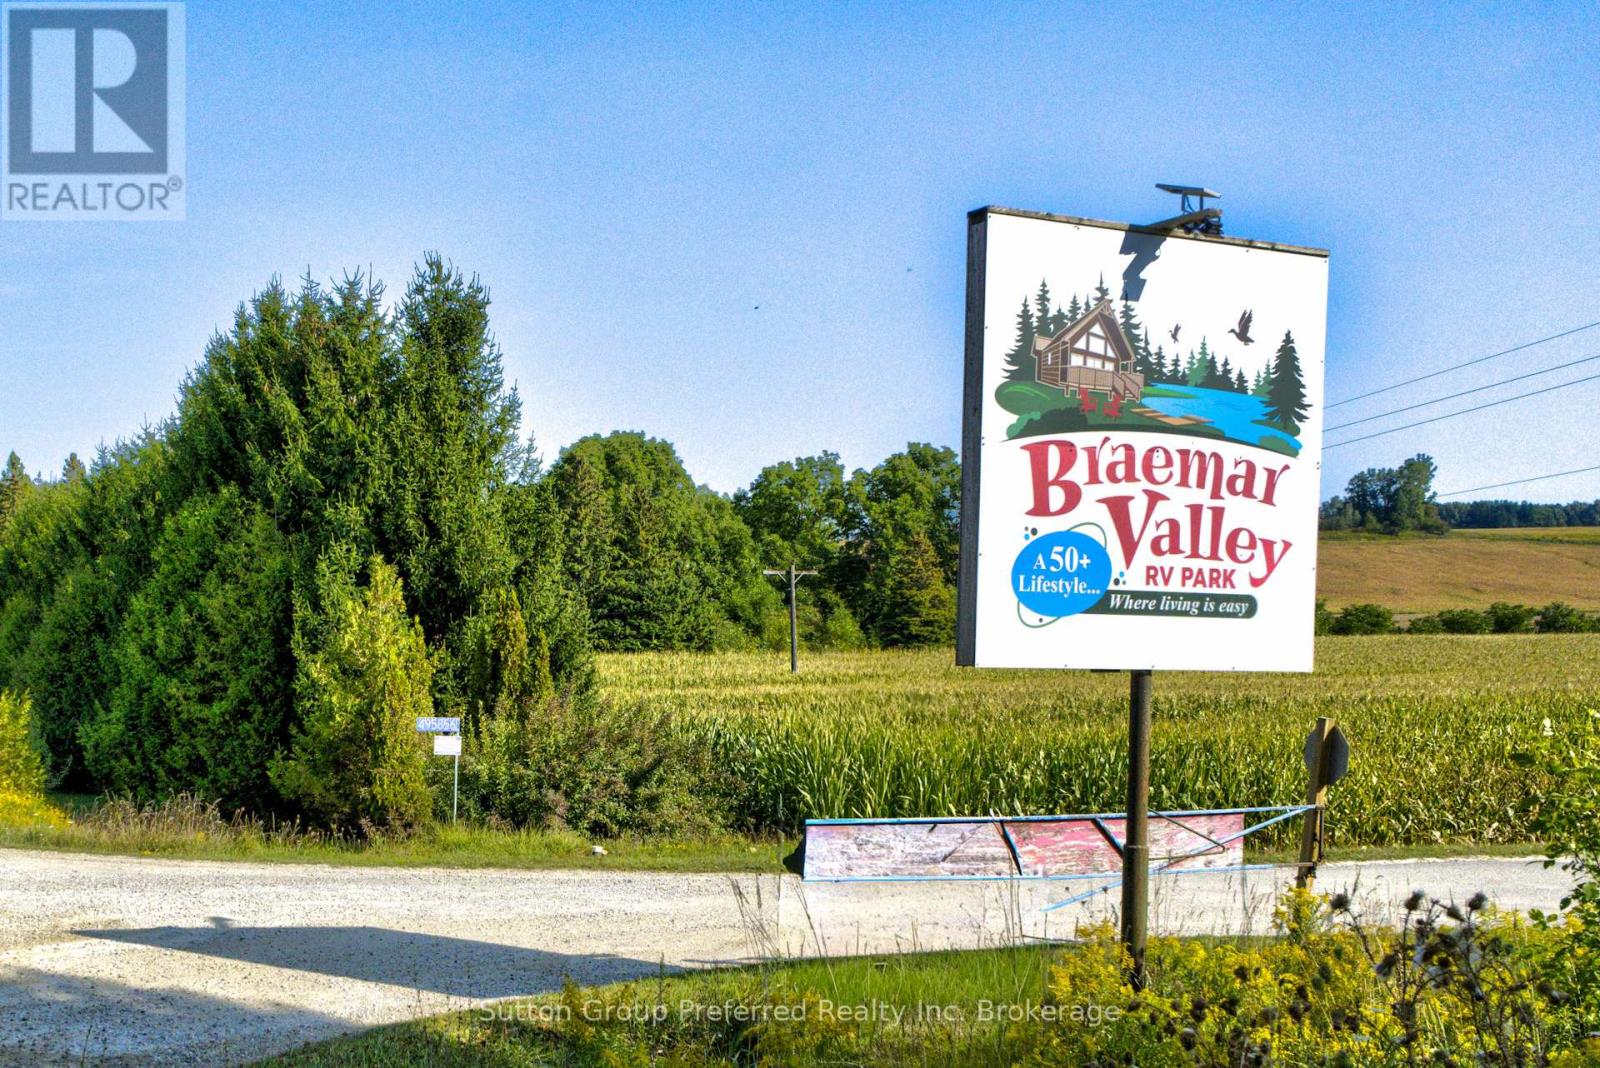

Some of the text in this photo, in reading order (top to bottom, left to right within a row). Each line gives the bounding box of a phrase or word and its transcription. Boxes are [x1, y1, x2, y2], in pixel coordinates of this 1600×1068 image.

[1019, 436, 1291, 518] Braemar
[1096, 489, 1293, 588] Valley
[1033, 545, 1092, 573] A 50+
[1018, 574, 1101, 598] Lifestyle...
[1145, 565, 1236, 589] RV PARK
[1109, 594, 1249, 616] Where living is easy
